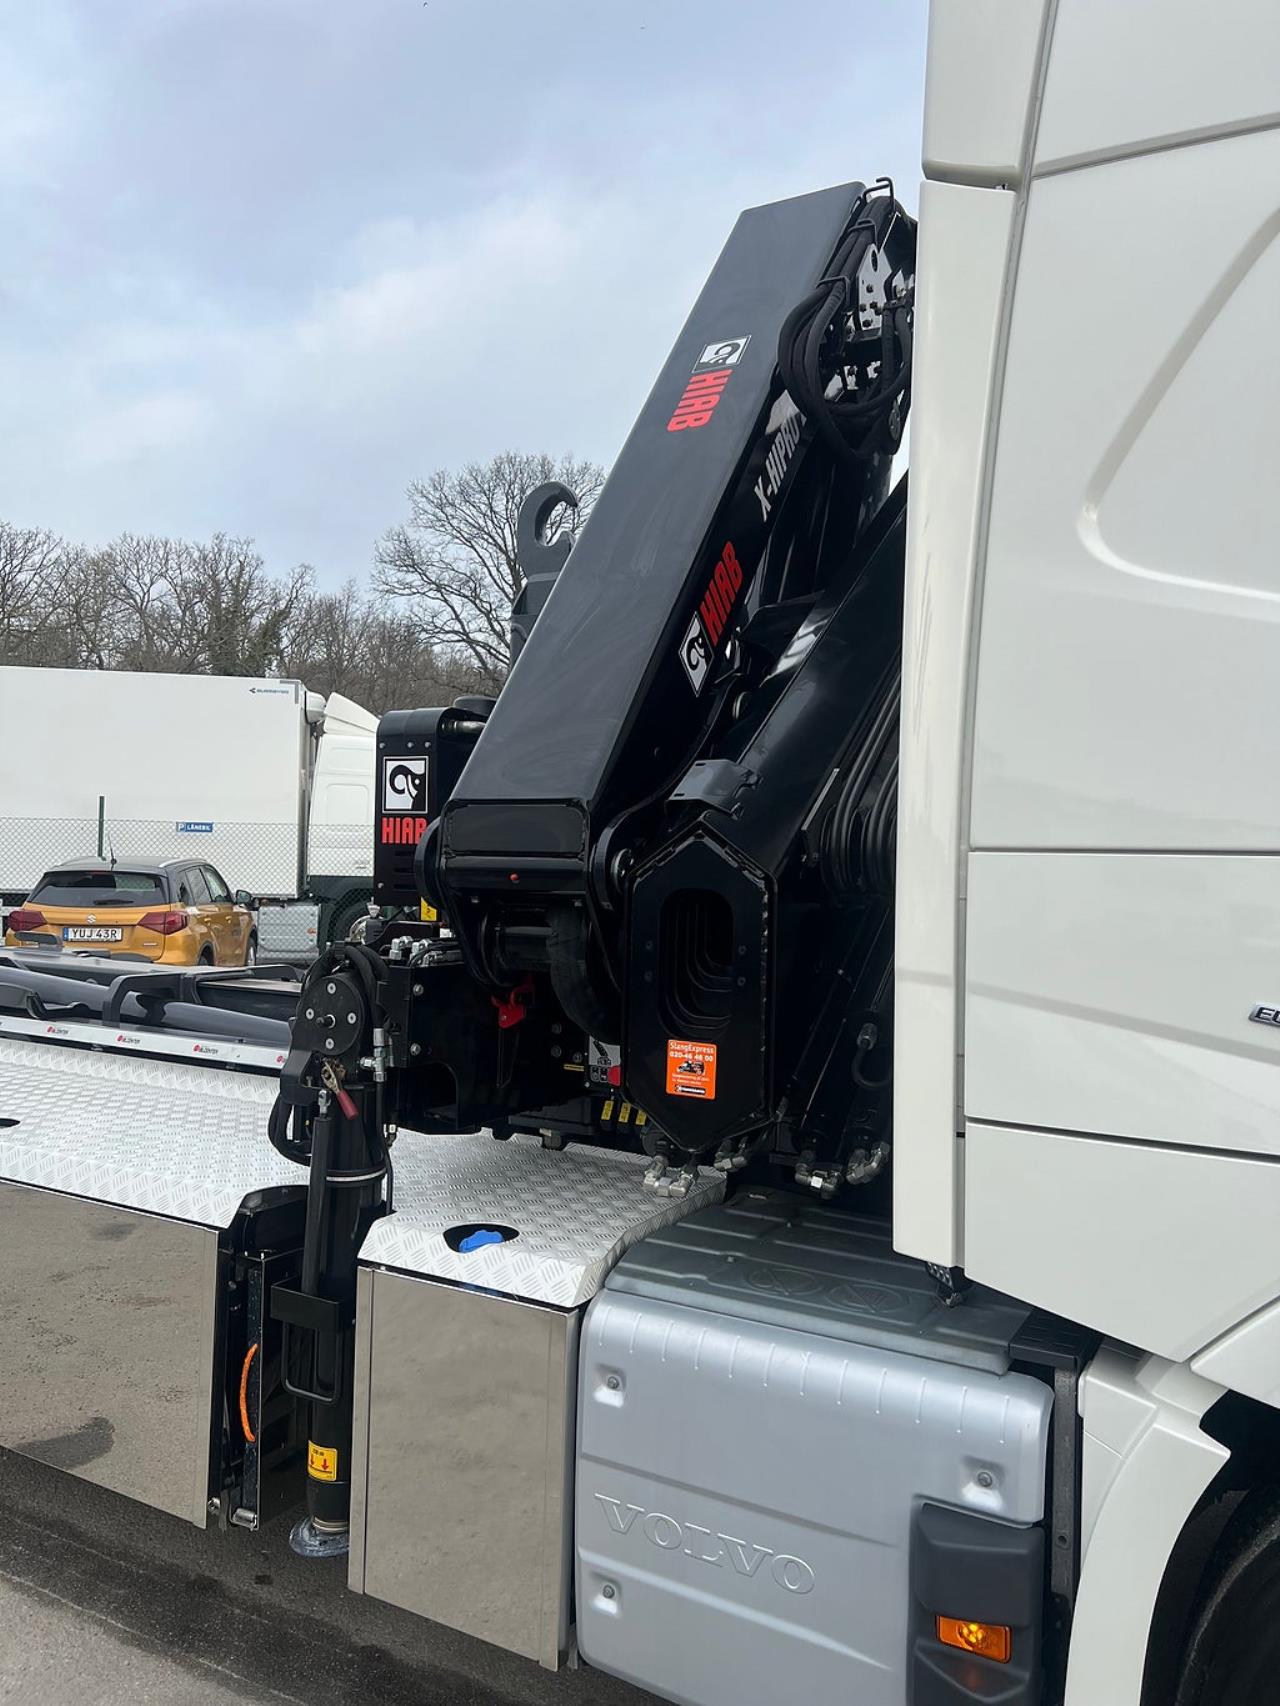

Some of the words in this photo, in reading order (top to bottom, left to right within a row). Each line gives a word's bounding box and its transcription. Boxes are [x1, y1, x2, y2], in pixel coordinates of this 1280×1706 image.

[667, 369, 733, 432] HIAB
[698, 541, 743, 647] HIAB
[72, 929, 93, 938] YUJ
[95, 929, 117, 939] 43R
[594, 1492, 816, 1595] VOLVO
